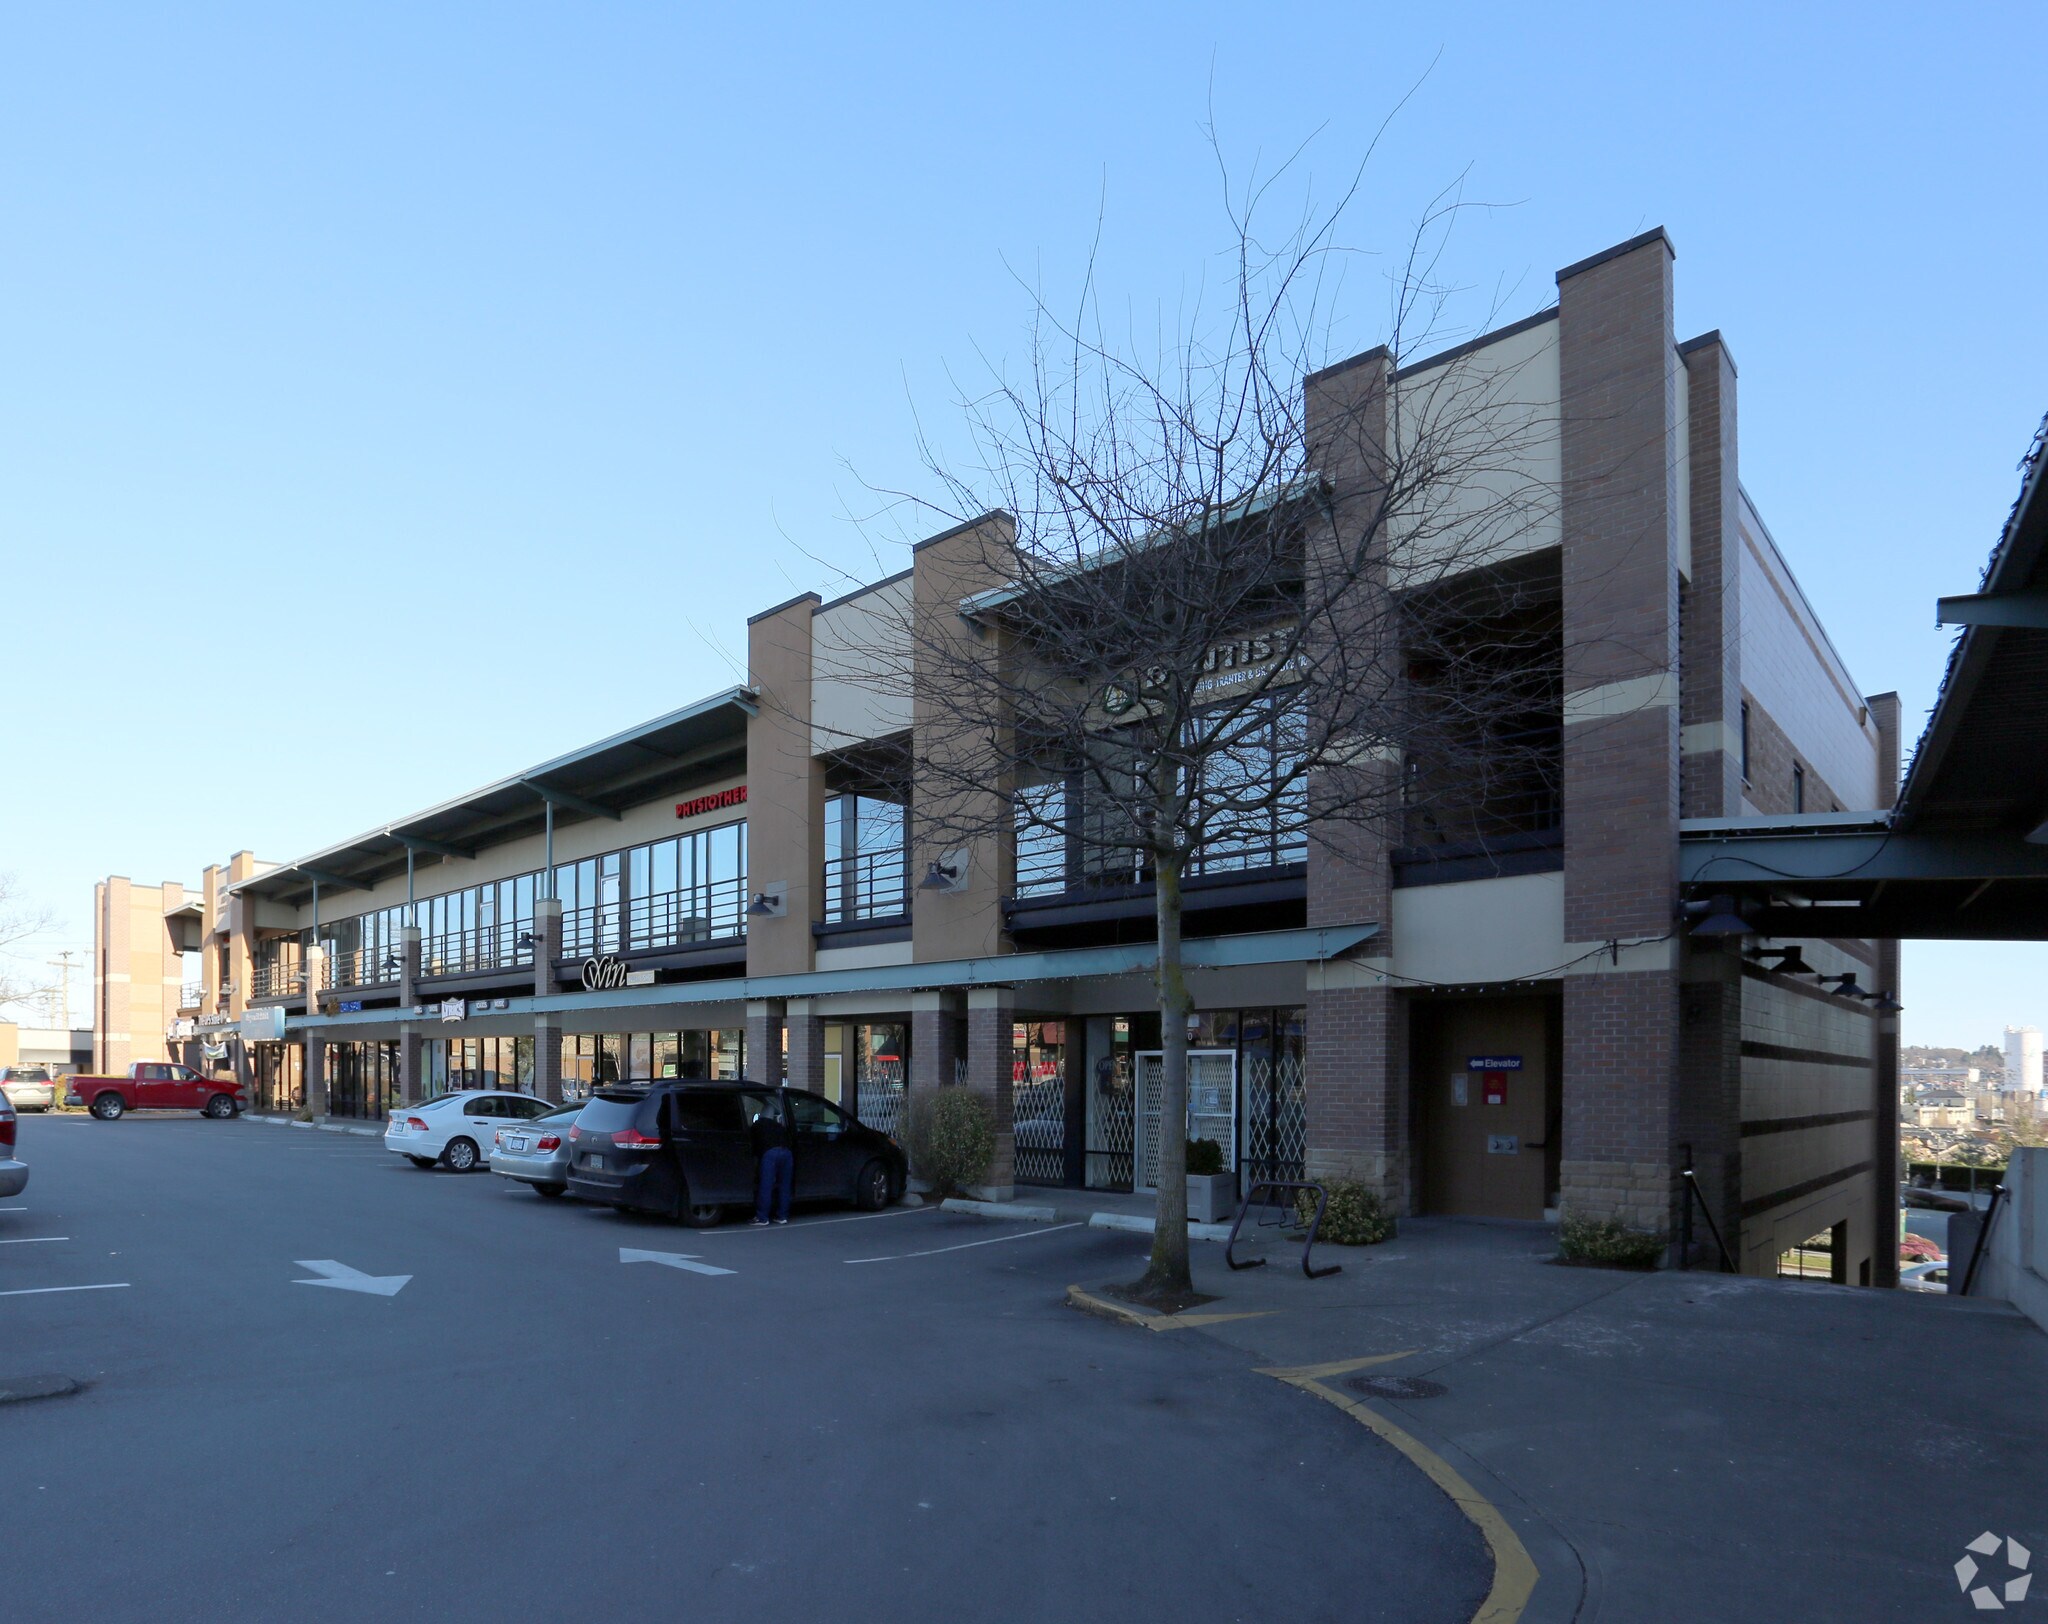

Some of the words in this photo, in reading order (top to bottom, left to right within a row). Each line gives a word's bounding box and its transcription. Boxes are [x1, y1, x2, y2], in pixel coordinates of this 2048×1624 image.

[675, 785, 747, 819] PHYSIOTHER
[581, 956, 626, 989] Win
[1484, 1058, 1521, 1068] Elevator
